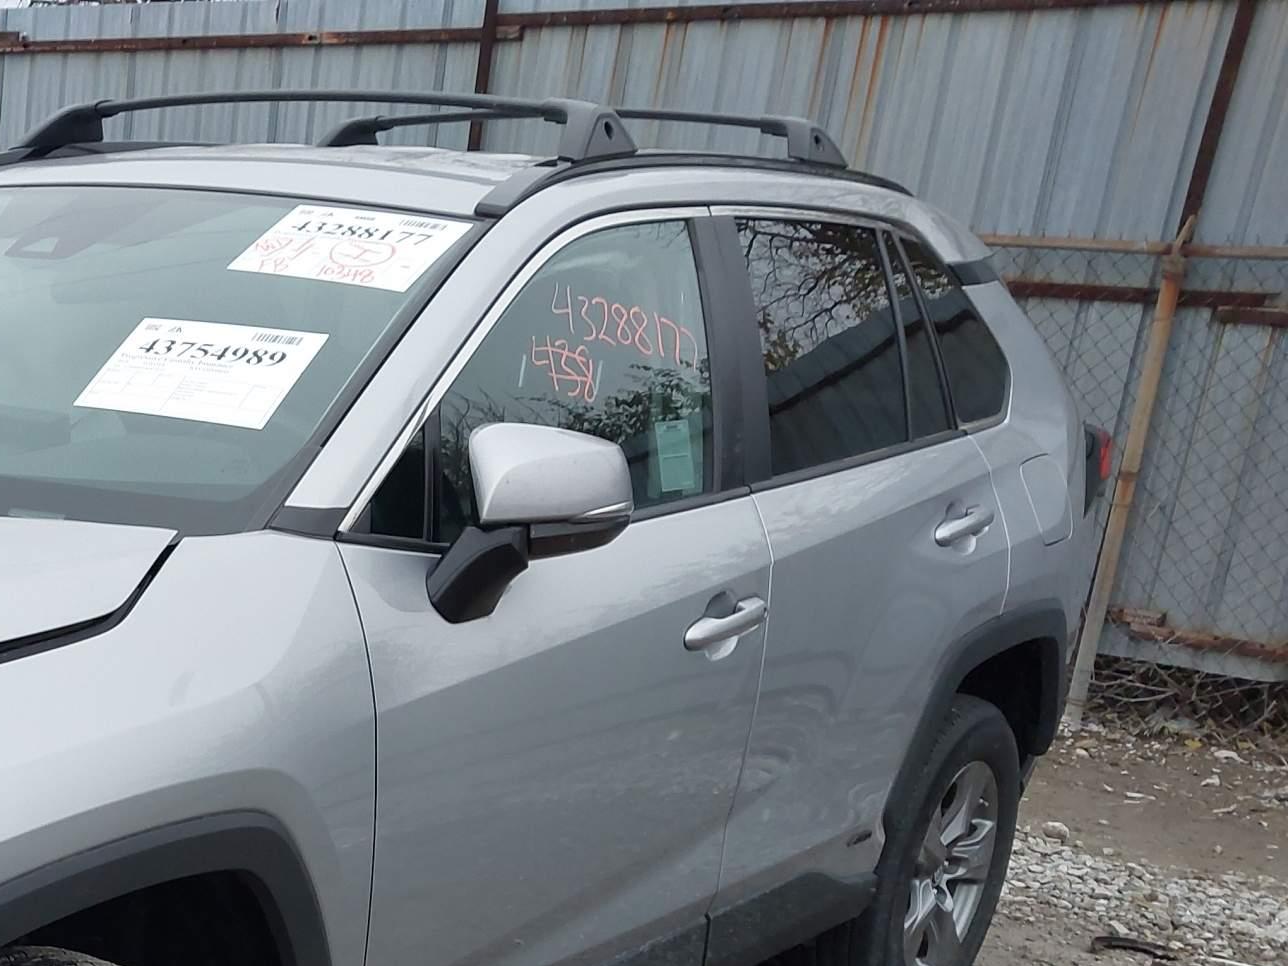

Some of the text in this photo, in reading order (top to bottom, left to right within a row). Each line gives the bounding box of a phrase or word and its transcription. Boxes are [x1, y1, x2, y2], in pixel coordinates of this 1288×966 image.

[292, 219, 433, 246] 43288177
[551, 282, 698, 373] 43288177
[139, 338, 288, 367] 43754989
